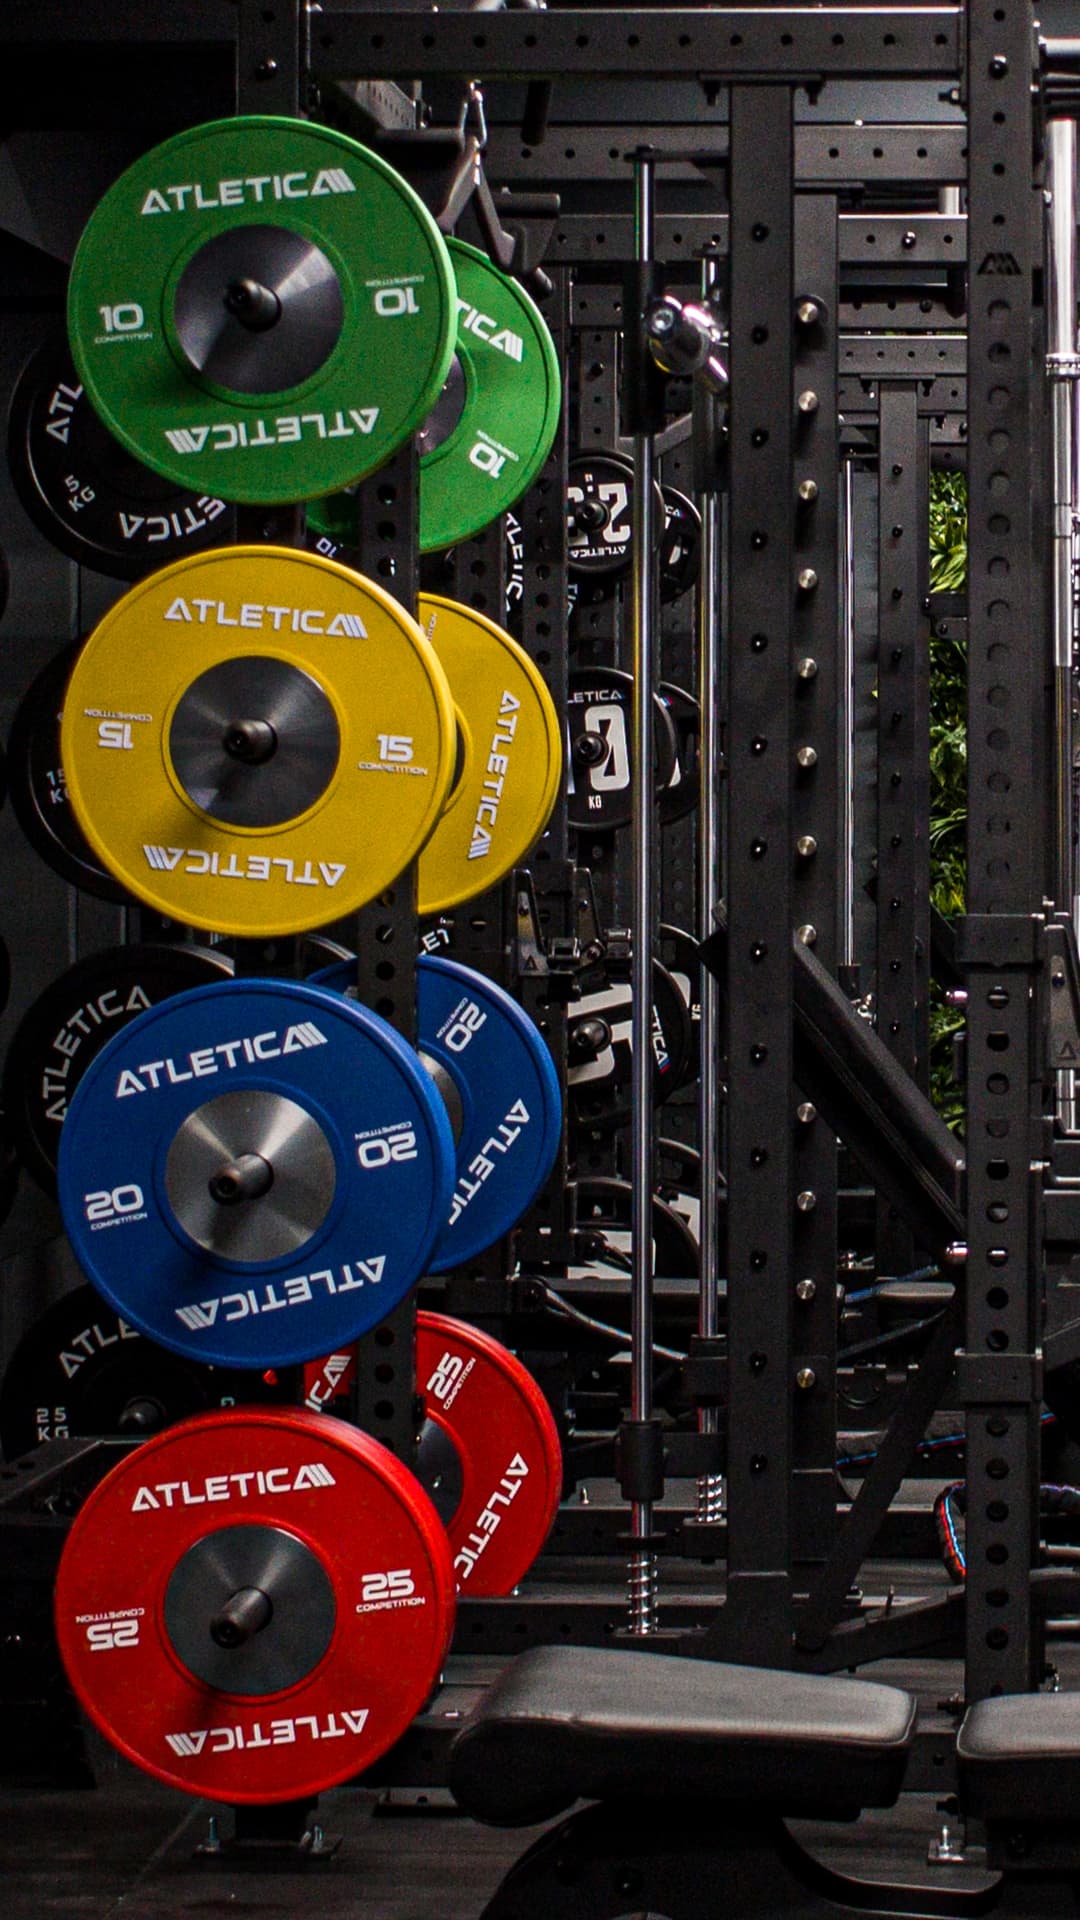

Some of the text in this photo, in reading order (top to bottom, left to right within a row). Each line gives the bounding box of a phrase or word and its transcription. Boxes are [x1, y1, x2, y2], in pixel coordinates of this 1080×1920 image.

[141, 168, 356, 216] ATLETICA
[99, 303, 144, 332] 10
[374, 287, 420, 316] 10
[165, 407, 380, 455] ATLETICA
[468, 441, 507, 479] 10
[64, 474, 81, 493] 5
[67, 485, 96, 513] KG
[163, 597, 369, 640] ATLETICA
[97, 721, 135, 751] 15
[376, 734, 415, 763] 15
[468, 689, 521, 861] ATLETICA
[142, 845, 347, 888] ATLETICA
[444, 1002, 488, 1052] 20
[41, 984, 153, 1123] ATLETICA
[115, 1021, 328, 1099] ATLETICA
[354, 1121, 413, 1140] COMPETITION
[357, 1134, 419, 1170] 20
[84, 1183, 145, 1222] 20
[90, 1211, 148, 1232] COMPETITION
[174, 1255, 388, 1333] ATLETICA
[426, 1352, 464, 1401] 25
[36, 1406, 68, 1424] 25
[130, 1463, 337, 1513] ATLETICA
[453, 1451, 529, 1594] ATLETIC
[361, 1568, 416, 1602] 25
[75, 1607, 146, 1625] COMPETITION
[355, 1596, 427, 1614] COMPETITION
[86, 1620, 141, 1653] 25
[165, 1707, 370, 1757] ATLETICA
